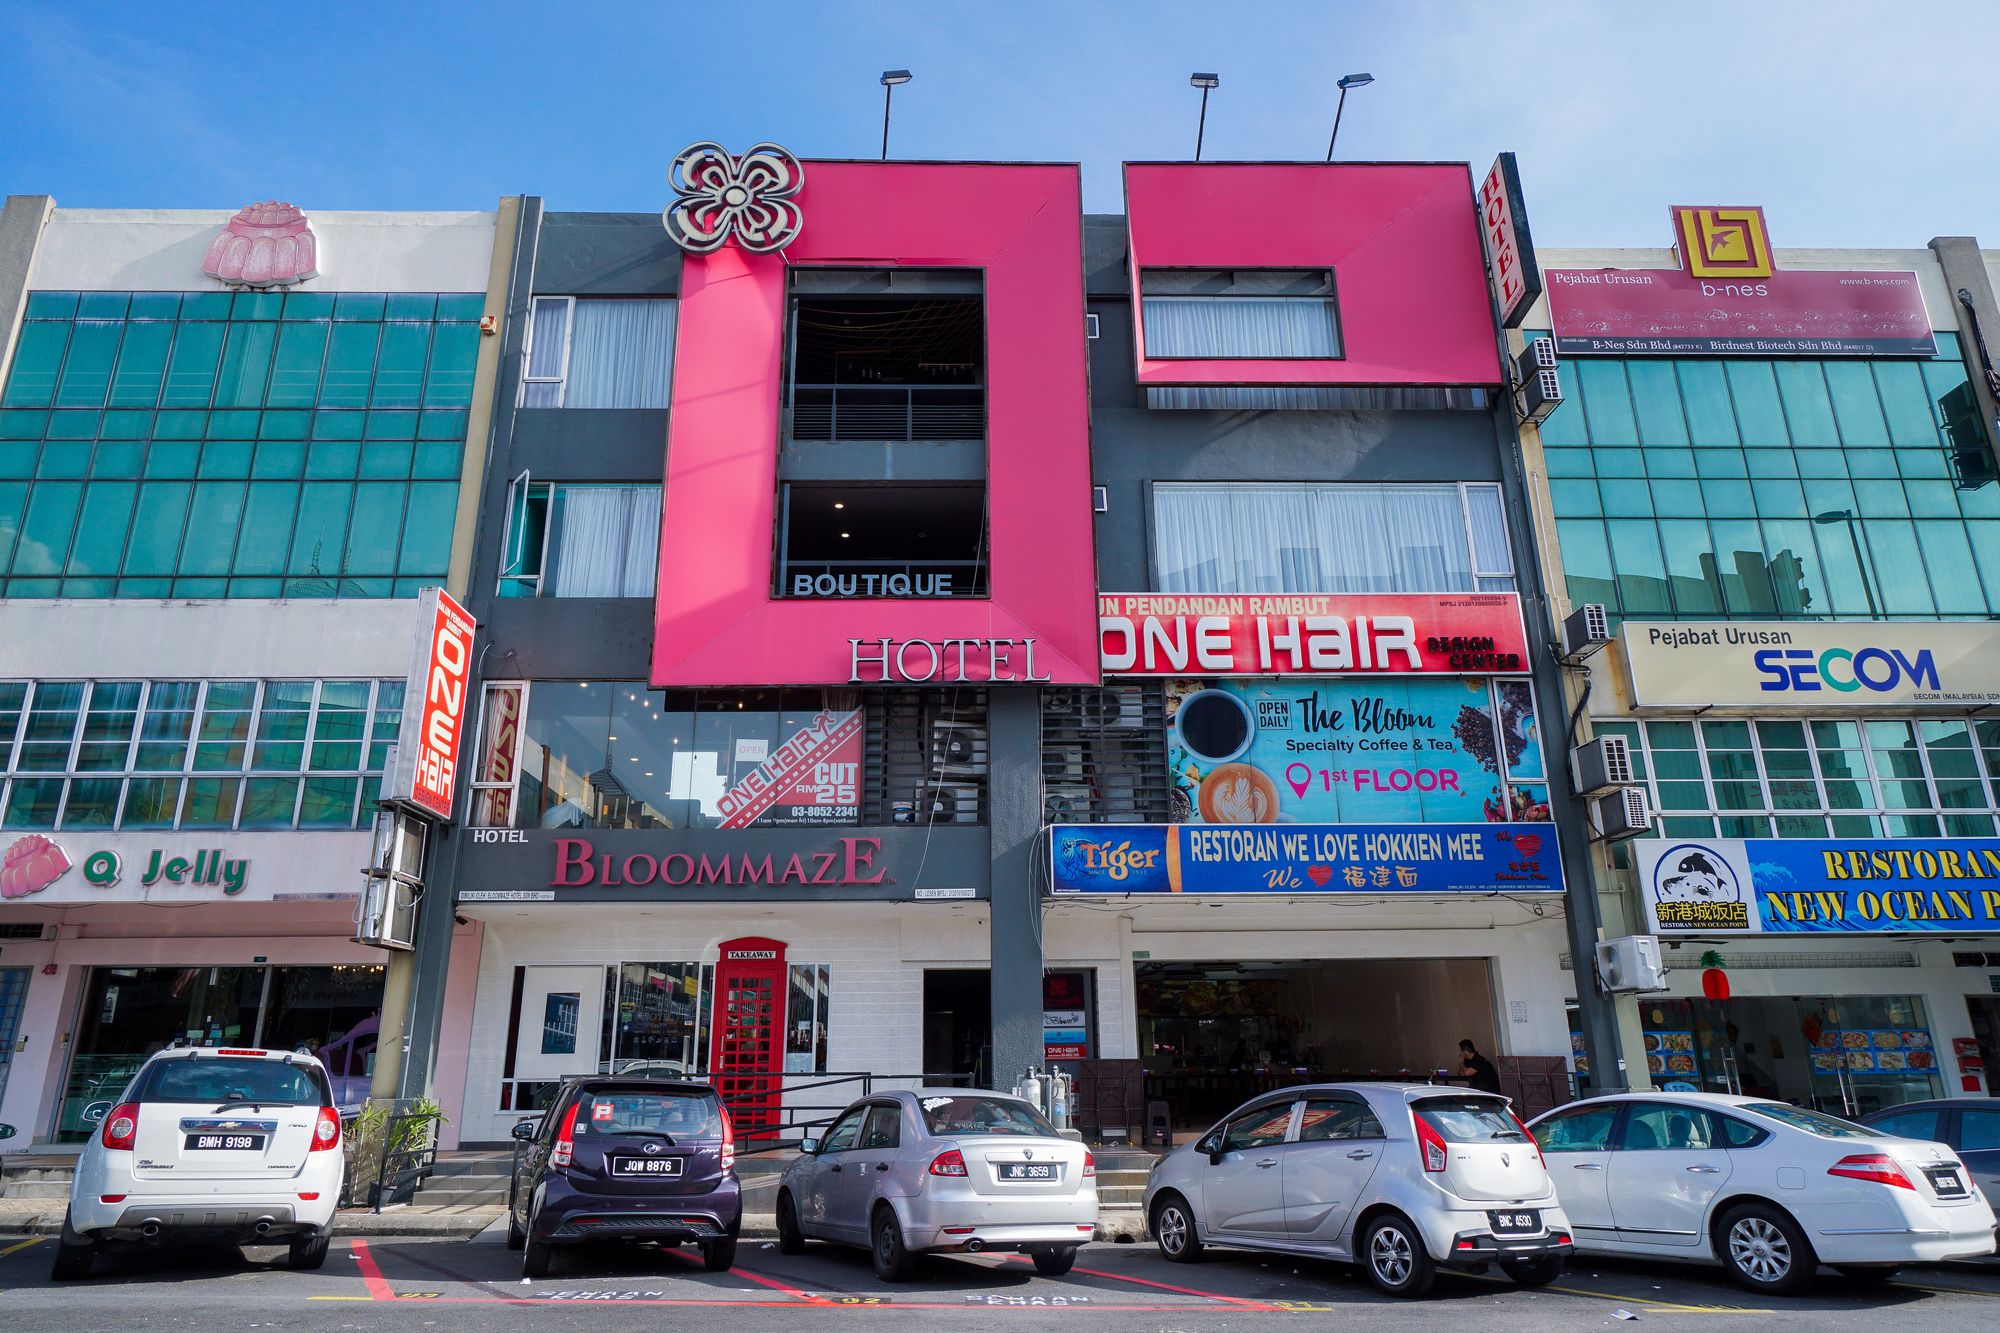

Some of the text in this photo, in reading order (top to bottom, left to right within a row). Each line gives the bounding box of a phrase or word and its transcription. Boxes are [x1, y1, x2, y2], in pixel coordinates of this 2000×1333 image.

[1482, 166, 1518, 305] HOTEL
[1555, 273, 1652, 286] Pejabat Urusan
[1839, 277, 1909, 286] www.b-nes.com
[1701, 281, 1768, 297] b-nes
[1593, 340, 1624, 350] B-Nes
[1626, 340, 1647, 350] Sdn
[1649, 340, 1672, 350] Bhd
[1710, 340, 1753, 350] Birdnest
[1757, 340, 1796, 350] Biotech
[1797, 340, 1820, 350] Sdn
[1821, 340, 1843, 350] Bhd
[793, 573, 953, 596] BOUTIQUE
[1125, 597, 1243, 616] PENDANDAN
[1249, 597, 1330, 616] RAMBUT
[1100, 615, 1234, 671] ONE
[1427, 636, 1495, 653] DESIGN
[1648, 627, 1792, 649] Pejabat Urusan
[847, 637, 1051, 683] HOTEL
[1449, 653, 1520, 669] CENTER
[1754, 647, 1942, 692] SECOM
[428, 627, 466, 757] ONE
[1942, 693, 1986, 701] (MALAYSIA)
[1259, 702, 1289, 715] OPEN
[1296, 691, 1436, 734] The Bloom
[1260, 715, 1289, 728] DAILY
[739, 745, 765, 755] OPEN
[1286, 738, 1354, 753] Specialty
[1359, 738, 1408, 751] Coffee
[1412, 738, 1423, 750] &
[814, 762, 859, 785] CUT
[1318, 768, 1459, 792] 1st FLOOR
[791, 805, 858, 817] 03-8052-2341
[473, 829, 529, 843] HOTEL
[1190, 830, 1484, 862] RESTORAN WE LOVE HOKKIEN MEE
[549, 837, 887, 887] BLOOMMAZE
[1080, 840, 1160, 880] Tiger
[1821, 849, 2000, 880] RESTORAN
[83, 849, 250, 895] Q Jelly
[1262, 865, 1303, 888] We
[1341, 865, 1418, 888] 福建面
[1656, 901, 1748, 921] 新港城饭店
[1764, 890, 1848, 921] NEW
[1855, 890, 1976, 921] OCEAN
[729, 951, 774, 959] TAKEAWAY
[595, 1105, 612, 1119] P
[198, 1136, 253, 1149] BMH 9198
[624, 1160, 672, 1172] JQW 8876
[1009, 1166, 1049, 1177] JNC 3659
[1499, 1214, 1532, 1227] BNC 4530
